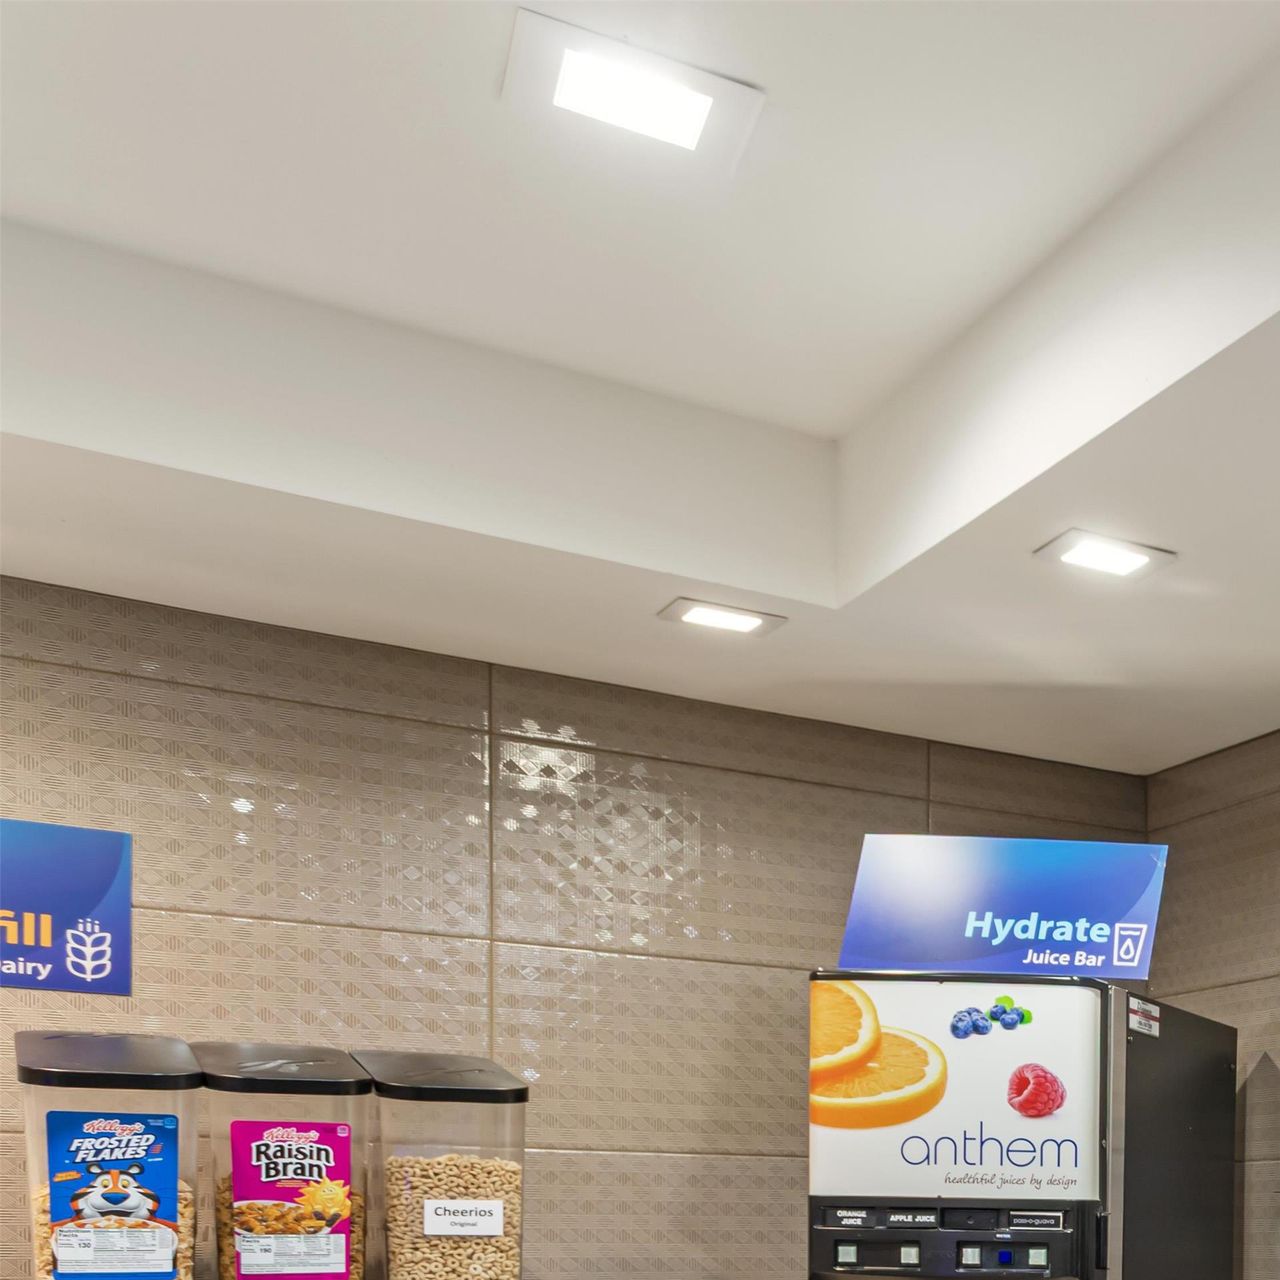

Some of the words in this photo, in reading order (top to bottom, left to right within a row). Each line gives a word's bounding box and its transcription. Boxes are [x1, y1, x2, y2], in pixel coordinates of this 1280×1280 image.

[964, 910, 1111, 946] Hydrate
[1022, 948, 1070, 966] Juice
[1074, 950, 1106, 967] Bar
[0, 956, 54, 980] airy
[83, 1118, 146, 1137] Kellogg's
[263, 1126, 320, 1144] Kellogg's
[68, 1134, 156, 1152] FROSTED
[900, 1120, 1078, 1168] anthem
[74, 1146, 148, 1163] FLAKES
[252, 1142, 334, 1166] Raisin
[264, 1160, 324, 1180] Bran
[944, 1172, 996, 1185] healthful
[996, 1174, 1026, 1189] juices
[1029, 1174, 1042, 1190] by
[1046, 1174, 1078, 1190] design
[434, 1206, 494, 1217] Cheerios
[836, 1210, 867, 1218] ORANGE
[890, 1214, 912, 1223] APPLE
[914, 1214, 936, 1223] JUICE
[841, 1216, 862, 1226] JUICE
